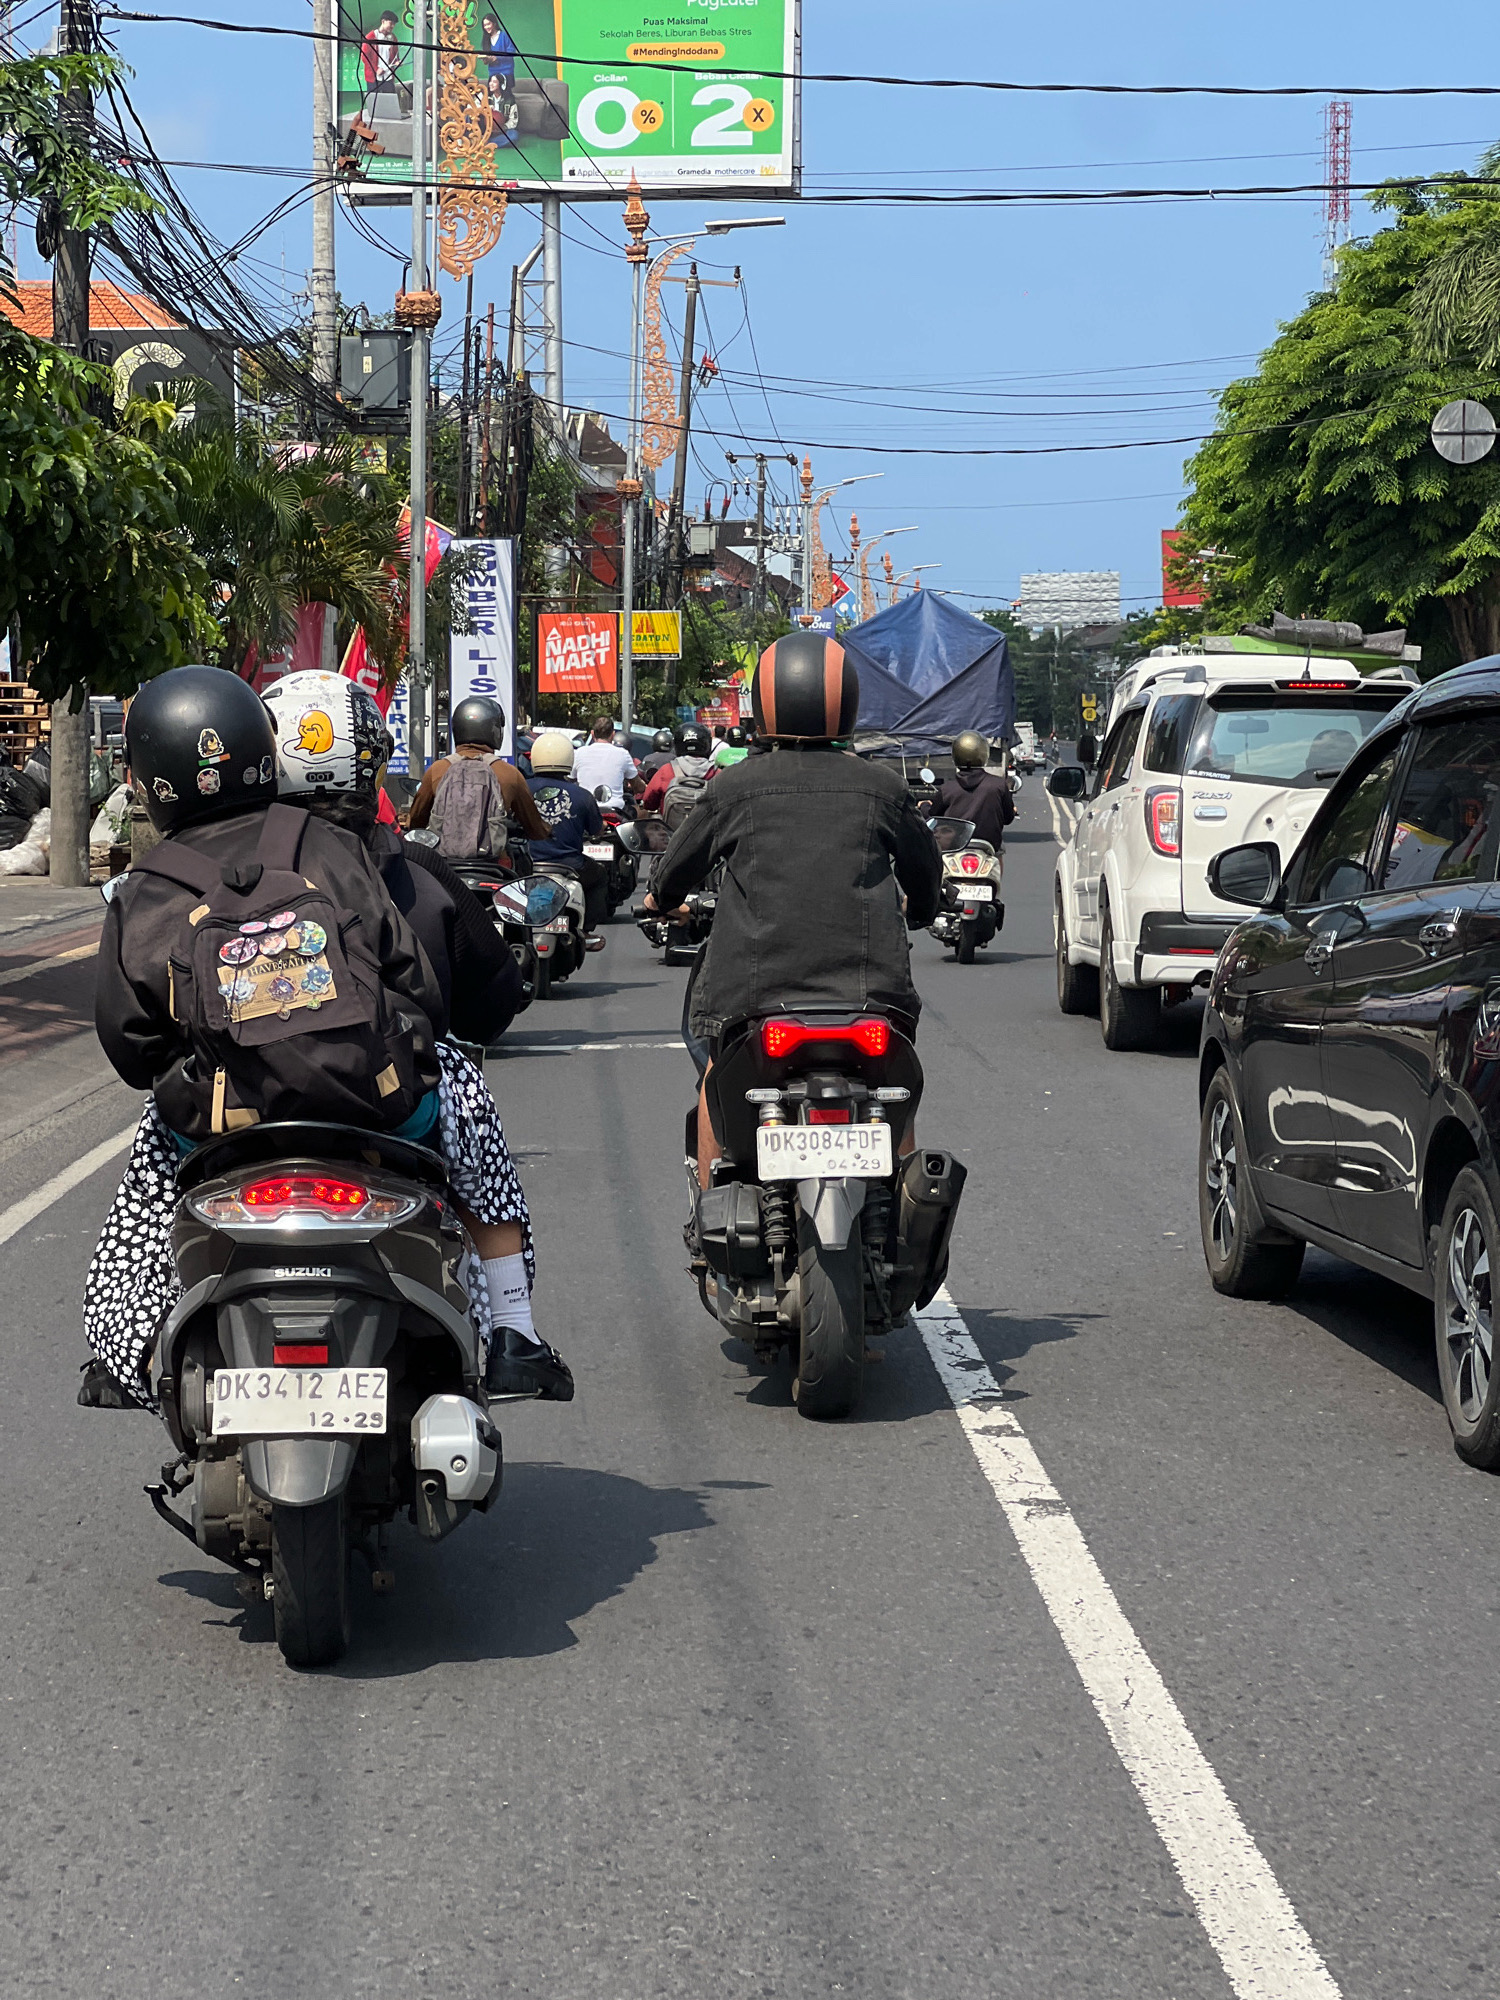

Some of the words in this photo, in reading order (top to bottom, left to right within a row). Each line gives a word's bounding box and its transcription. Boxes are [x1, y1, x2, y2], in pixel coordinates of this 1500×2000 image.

[643, 18, 664, 26] Puas
[667, 17, 708, 25] Maksimal
[599, 30, 634, 38] Sekolah
[636, 29, 663, 38] Beres,
[665, 29, 698, 37] Liburan
[700, 28, 727, 36] Bebas
[729, 28, 752, 36] Stres
[633, 47, 719, 58] #MendingIndodana
[593, 74, 628, 83] Cicilan
[604, 168, 627, 176] acer
[714, 167, 756, 175] mothercare
[798, 621, 832, 630] ONE
[545, 629, 610, 657] NADHI
[545, 646, 610, 675] MART
[468, 649, 497, 698] LIS
[309, 772, 331, 782] DOT
[248, 960, 280, 977] HAVE
[274, 1267, 331, 1278] SUZUKI
[337, 1372, 386, 1399] AEZ
